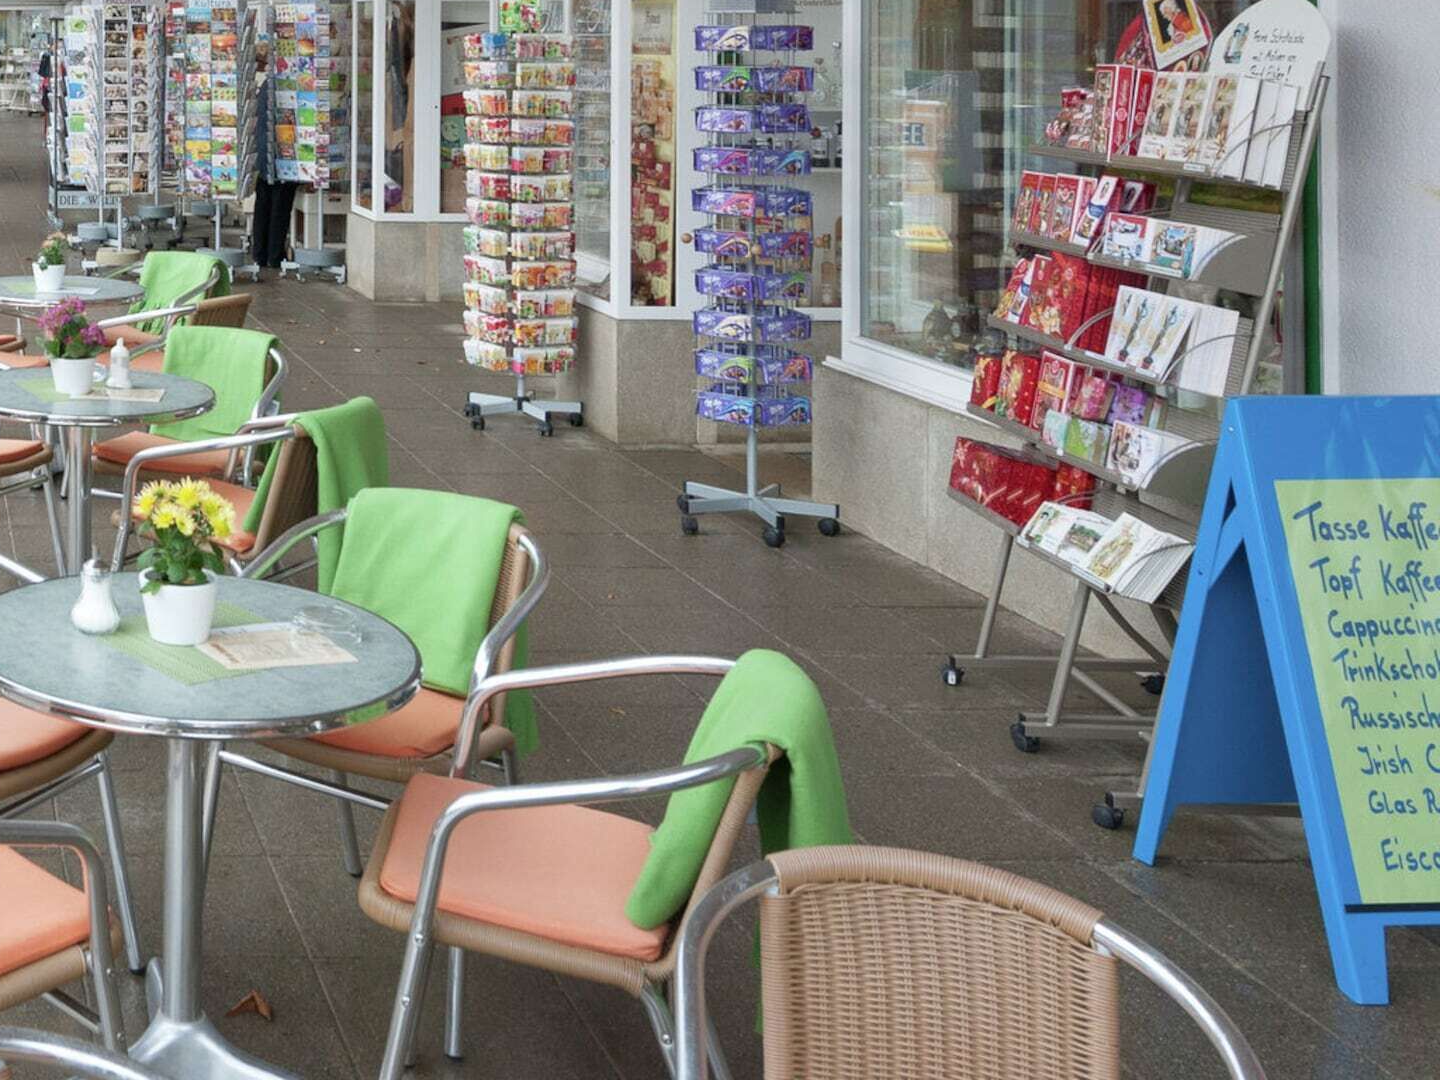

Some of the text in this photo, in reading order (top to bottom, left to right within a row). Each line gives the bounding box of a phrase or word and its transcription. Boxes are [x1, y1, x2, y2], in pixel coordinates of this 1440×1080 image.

[1293, 500, 1440, 551] Tasse Kaffe
[1309, 555, 1364, 600] Topf
[1368, 790, 1417, 814] Glas
